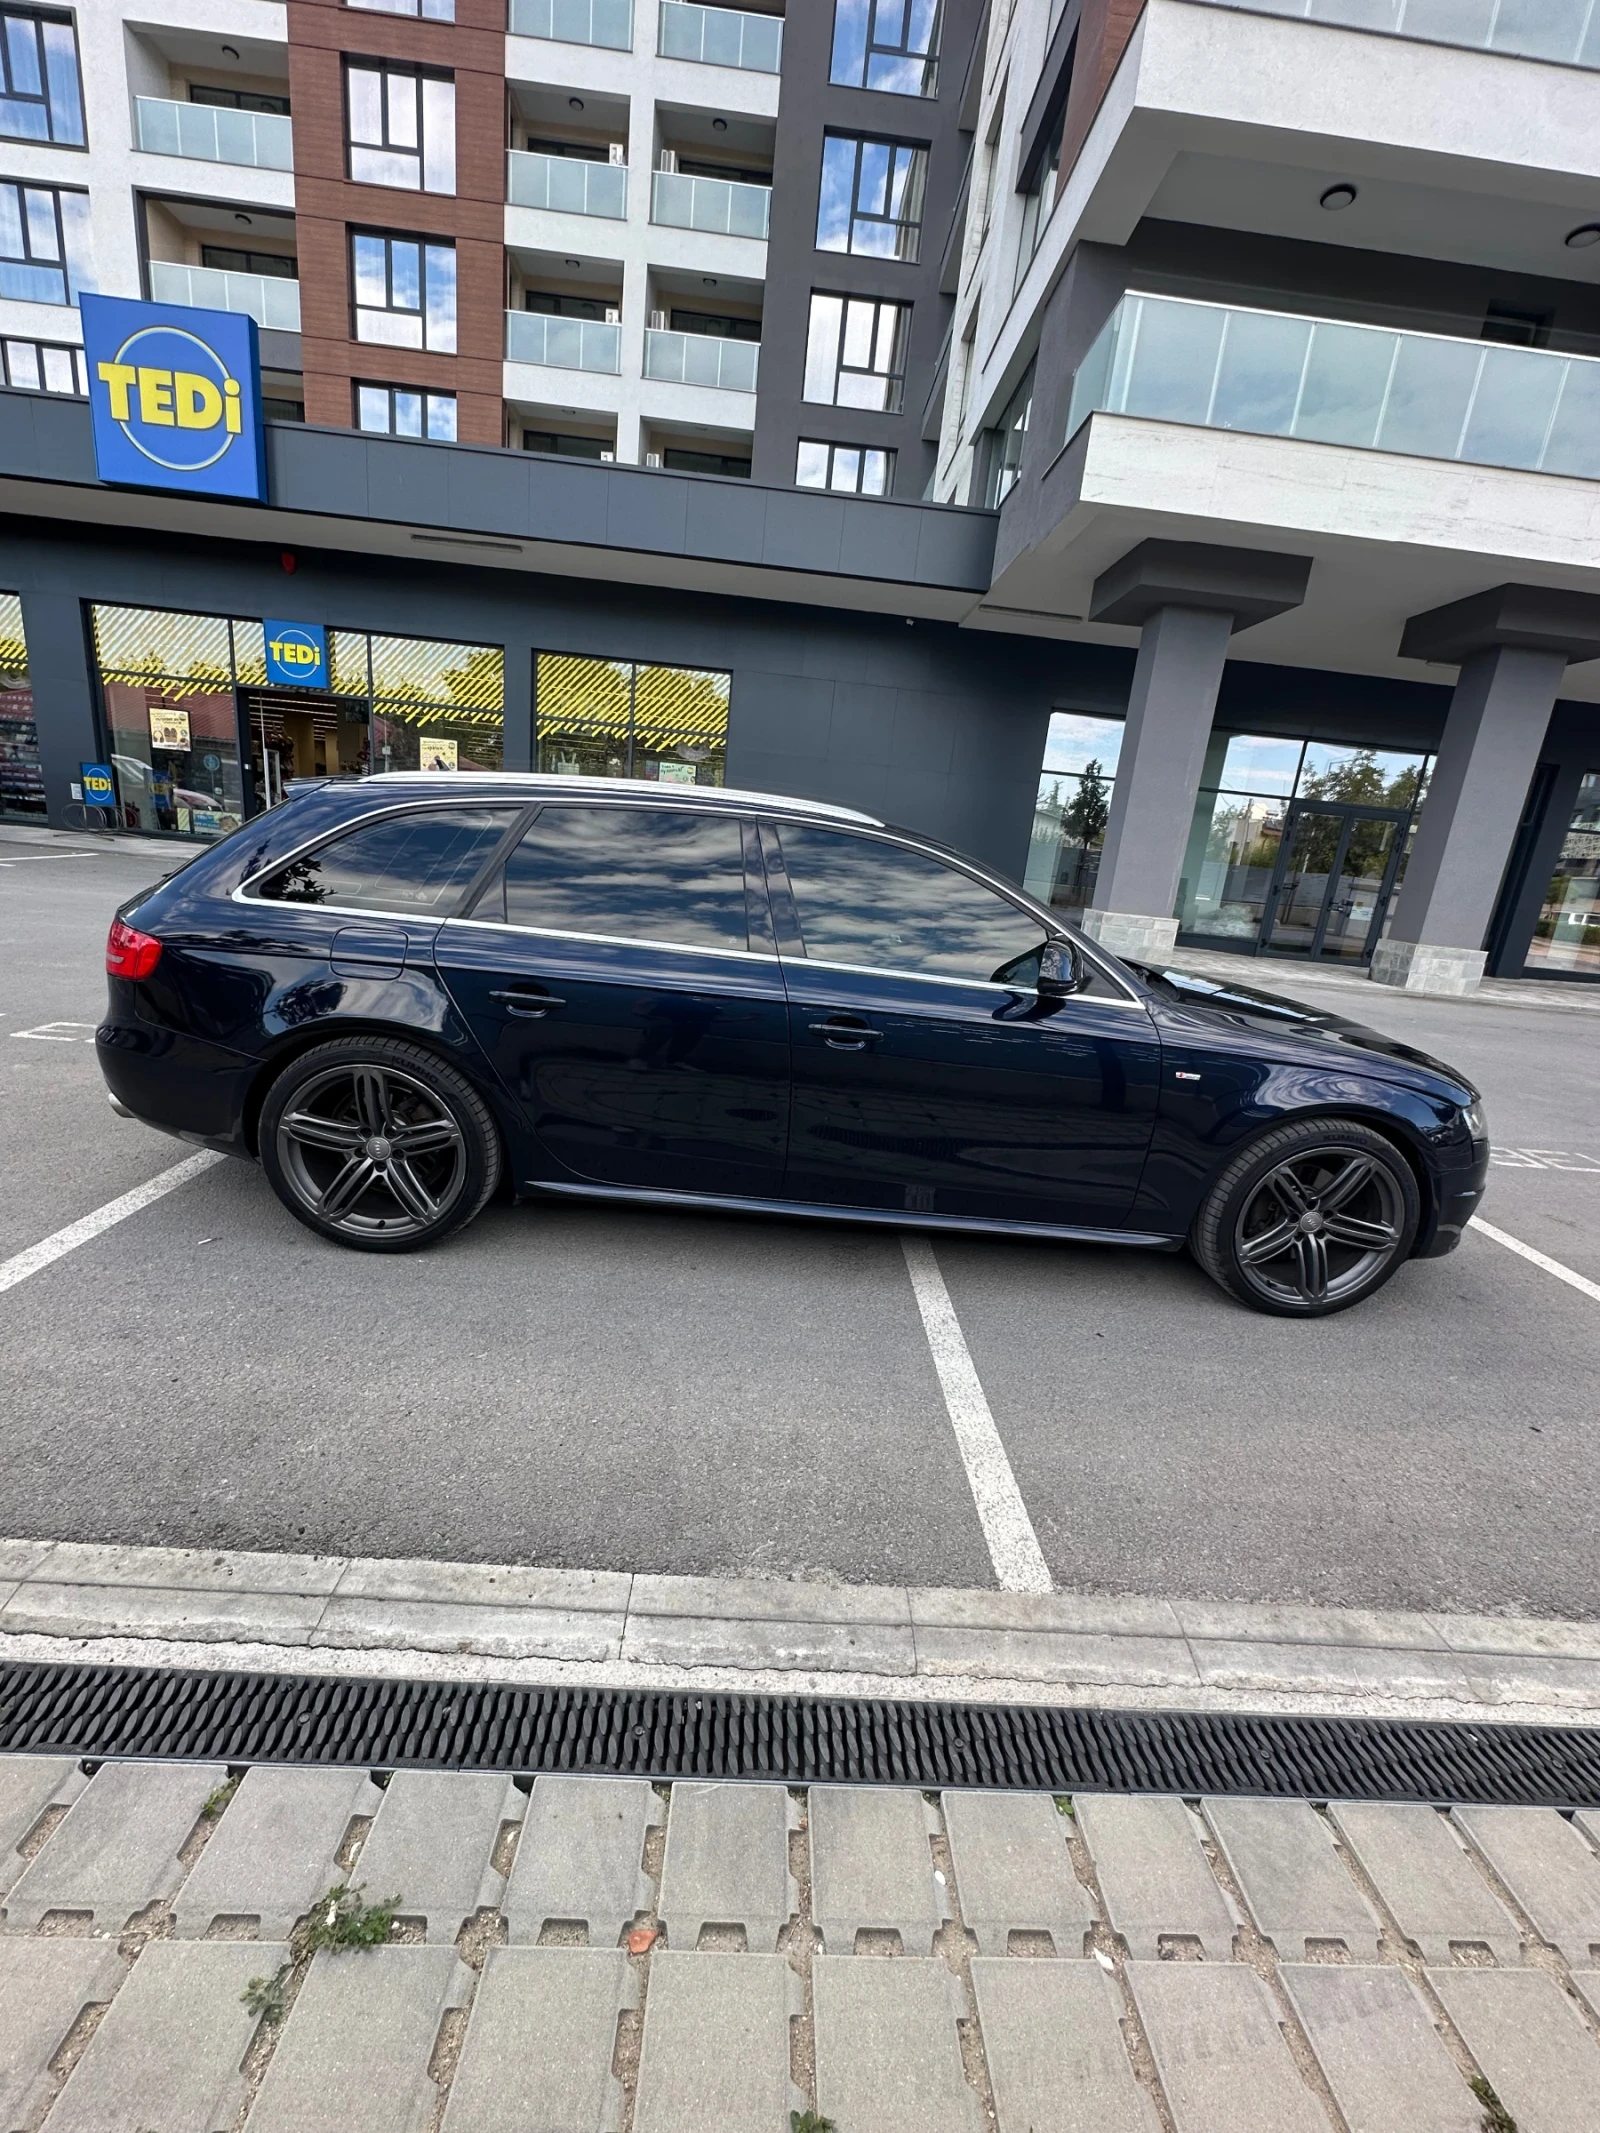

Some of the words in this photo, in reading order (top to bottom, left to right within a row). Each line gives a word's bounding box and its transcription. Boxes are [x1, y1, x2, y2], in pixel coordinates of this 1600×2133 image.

[98, 362, 241, 433] TEDi
[269, 641, 321, 666] TEDi
[83, 776, 112, 791] TEDi
[391, 1055, 439, 1084] KUMHO
[1323, 1134, 1368, 1146] KUMHO
